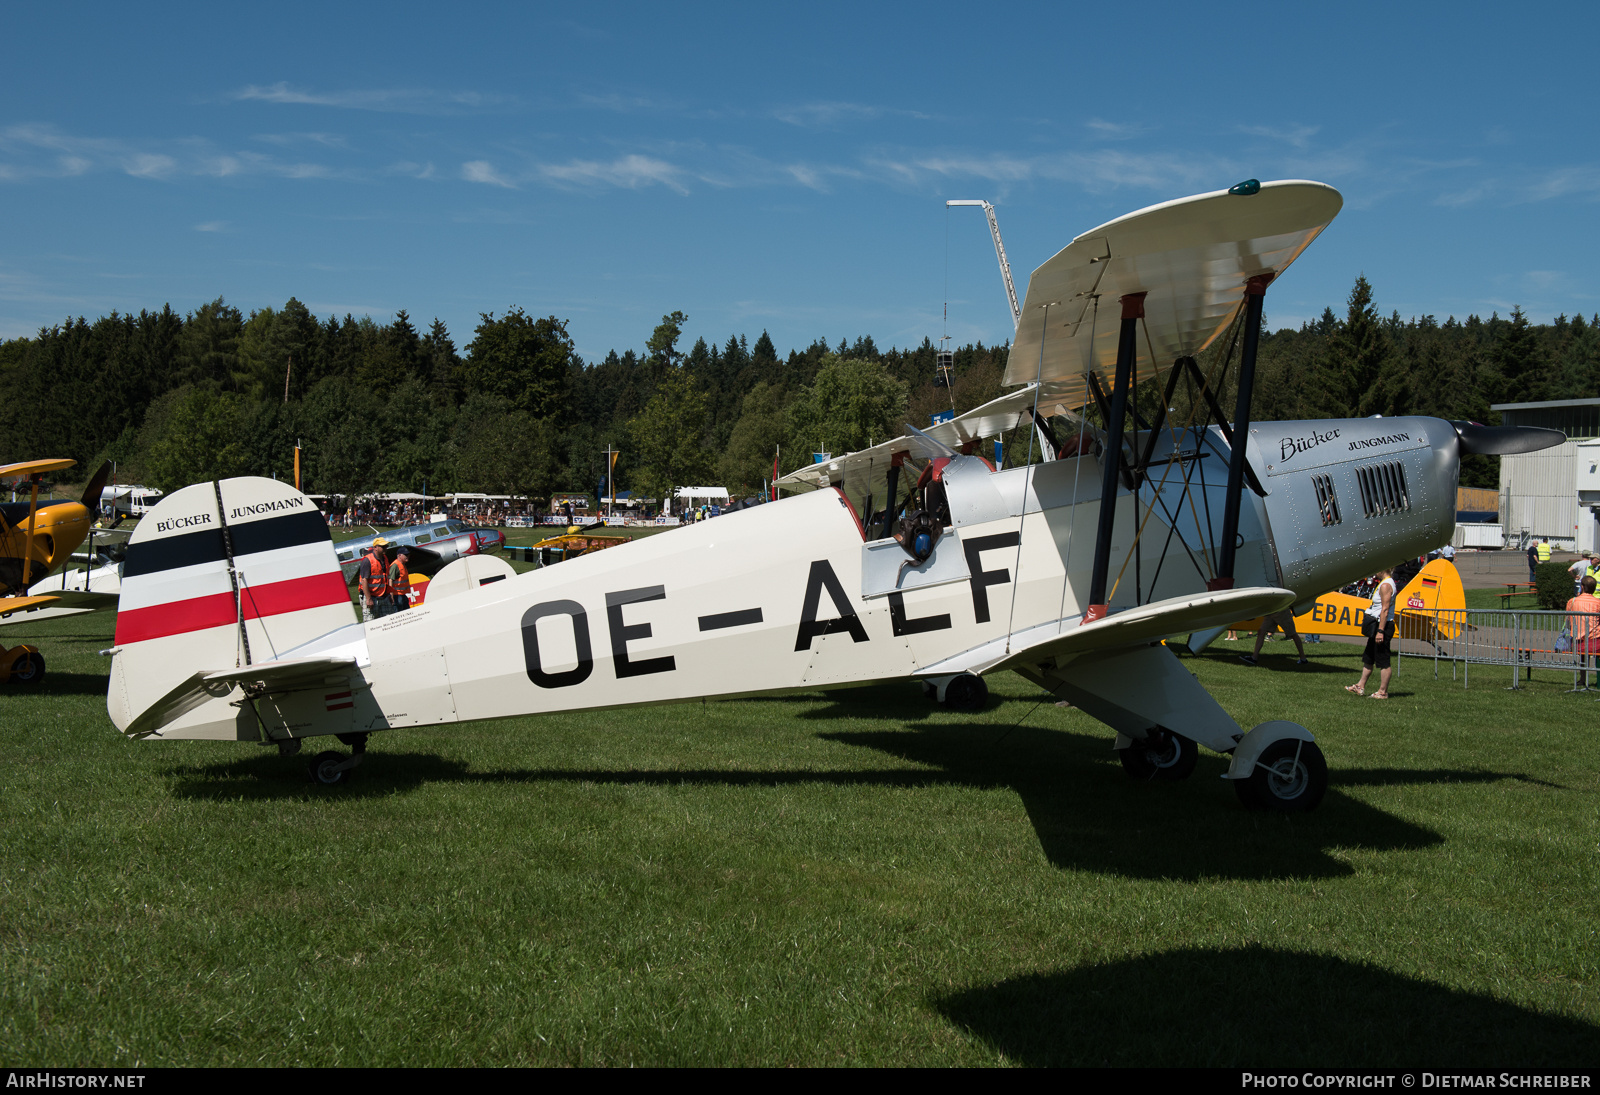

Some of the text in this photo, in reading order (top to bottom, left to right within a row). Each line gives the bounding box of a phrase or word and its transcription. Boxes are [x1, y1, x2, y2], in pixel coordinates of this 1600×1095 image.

[1278, 428, 1411, 463] Bücker JUNGMANN
[156, 497, 304, 532] BÜCKER JUNGMANN
